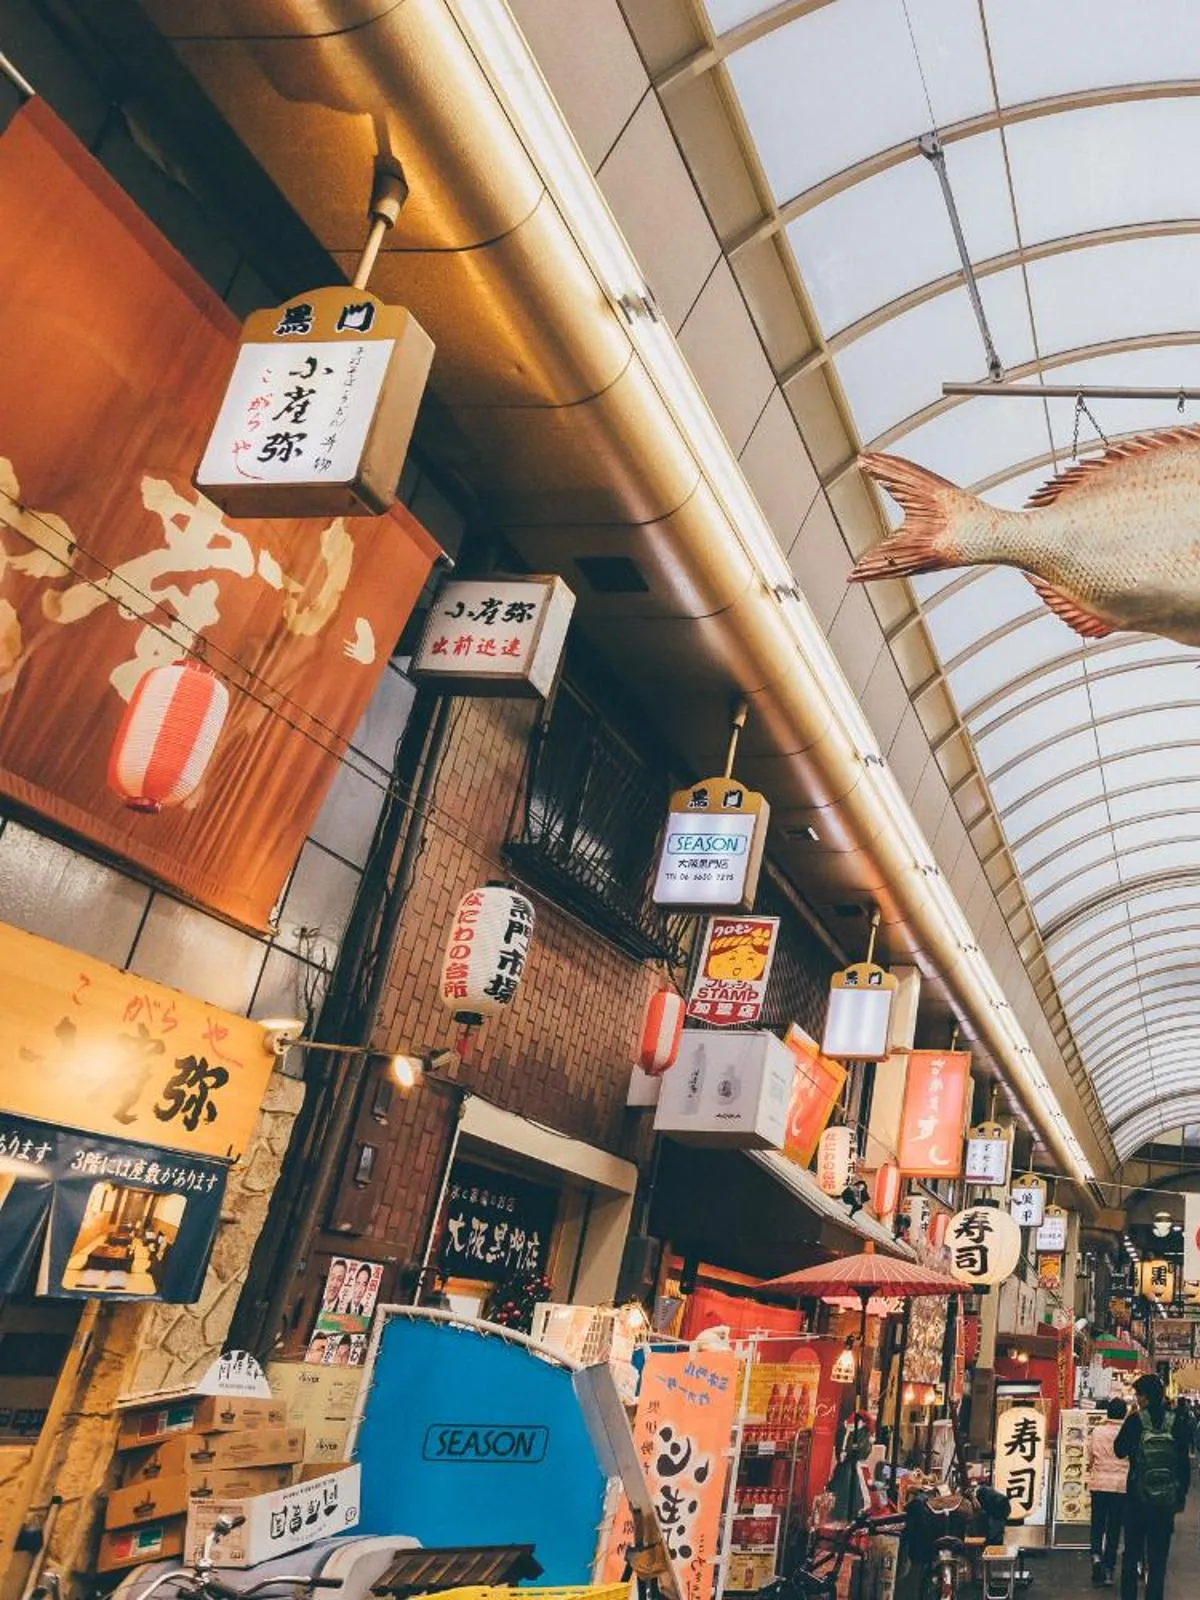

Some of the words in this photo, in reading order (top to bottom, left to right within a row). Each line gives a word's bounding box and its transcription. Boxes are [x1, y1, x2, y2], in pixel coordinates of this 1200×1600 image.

[276, 302, 375, 335] 黒門
[431, 633, 522, 658] 出前迅速
[688, 788, 743, 808] 黒門
[675, 836, 739, 852] SEASON
[714, 924, 753, 937] クロモン
[483, 895, 535, 1004] 黒門市場
[697, 987, 759, 1002] STAMP
[445, 1211, 541, 1271] 大阪黒門店
[953, 1209, 994, 1276] 寿司
[436, 1427, 535, 1458] SEASON
[1004, 1416, 1042, 1511] 寿司
